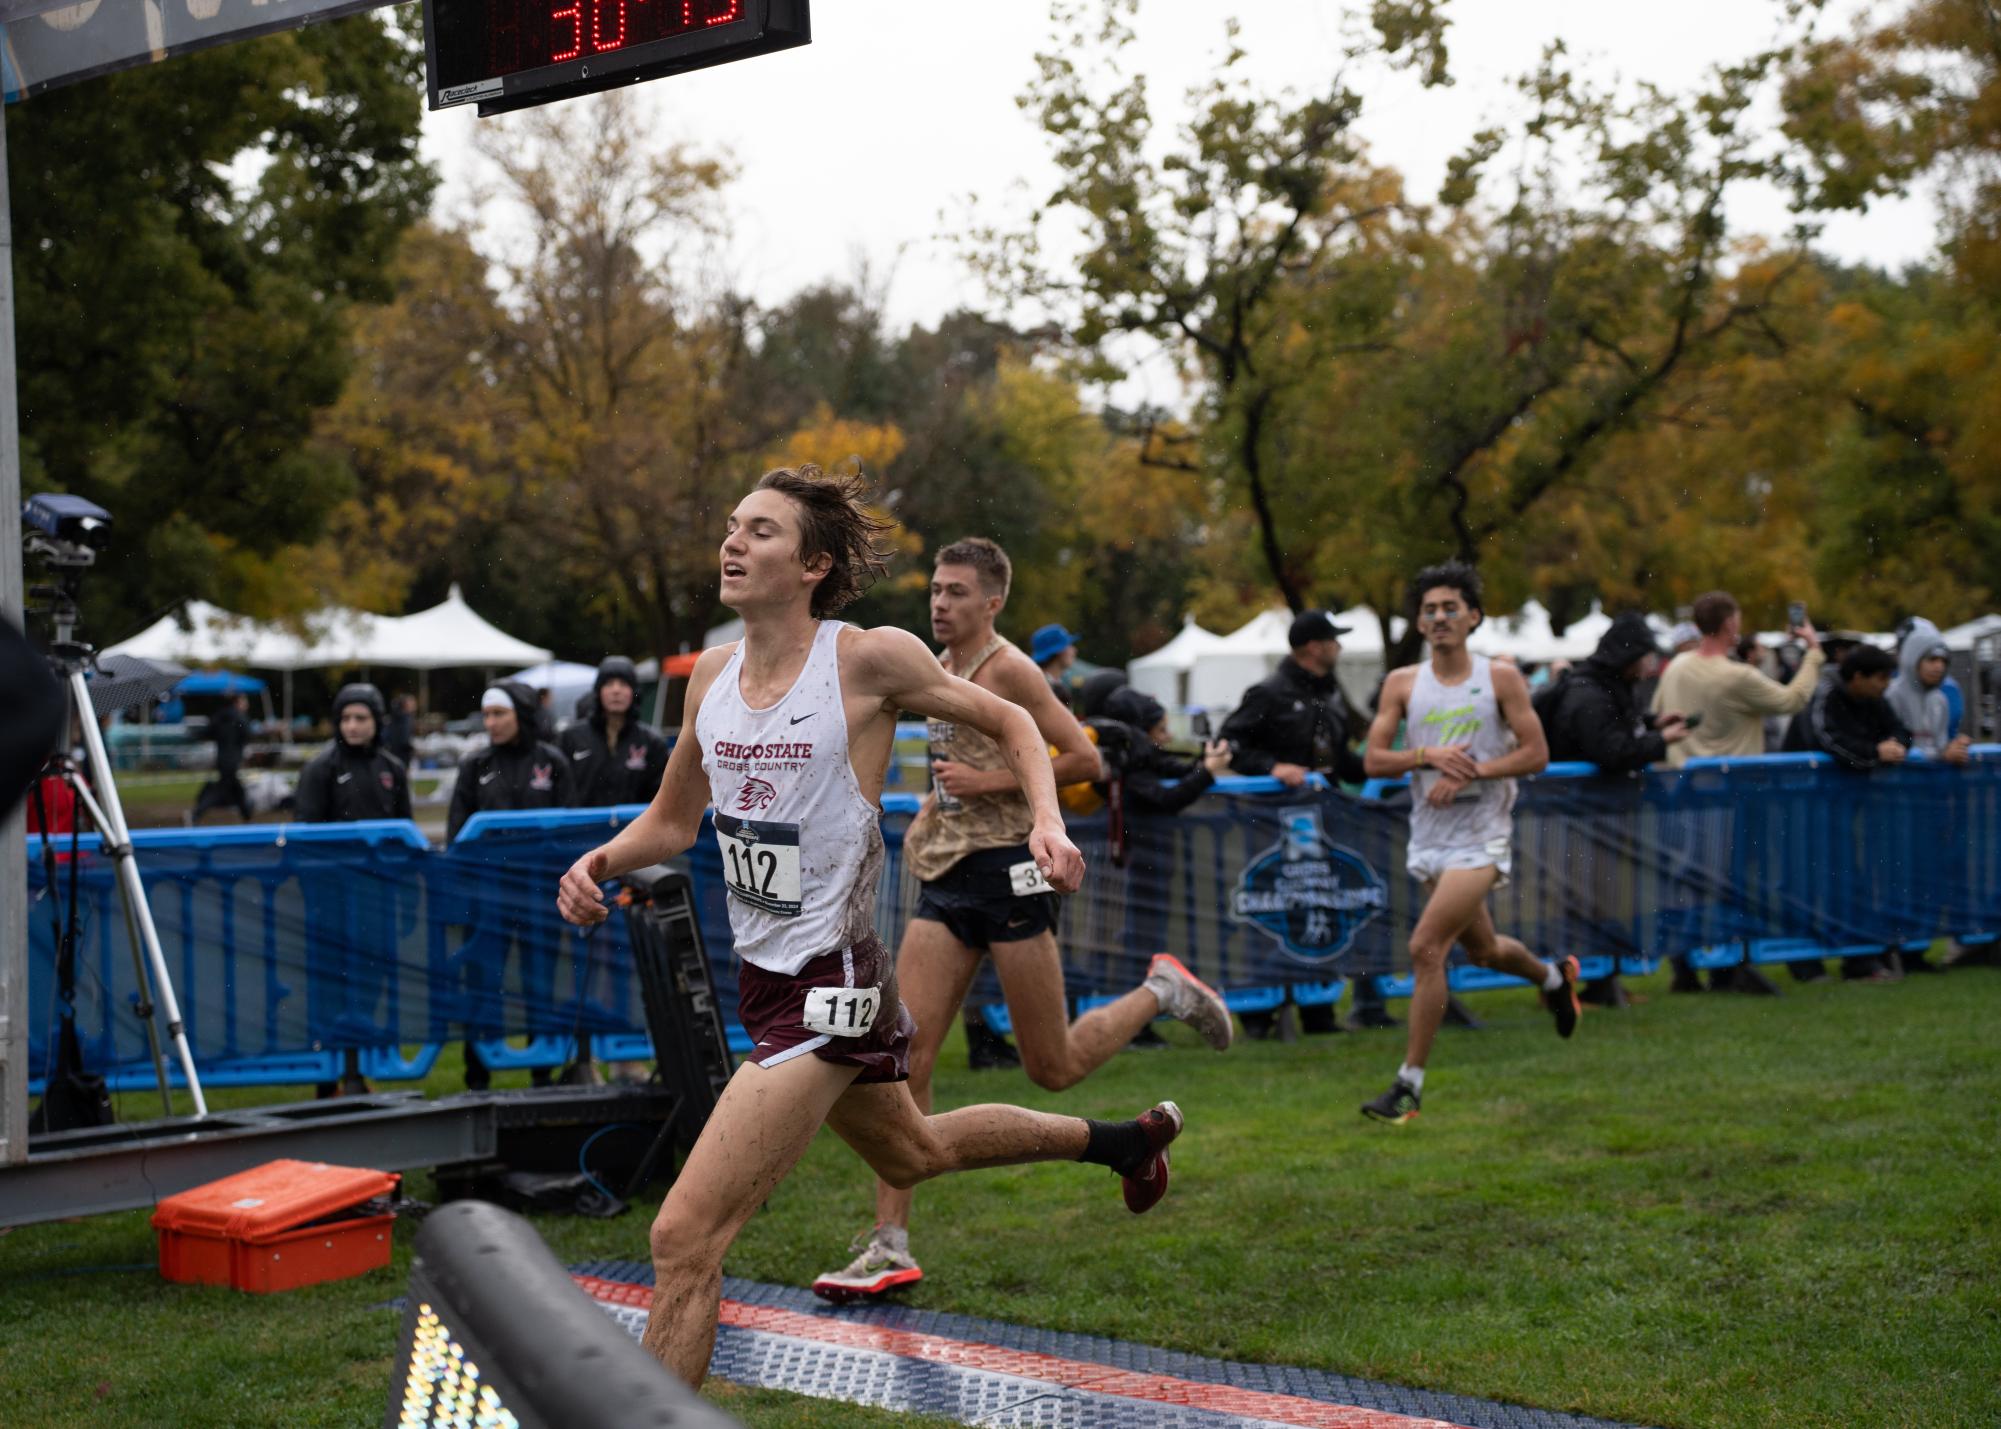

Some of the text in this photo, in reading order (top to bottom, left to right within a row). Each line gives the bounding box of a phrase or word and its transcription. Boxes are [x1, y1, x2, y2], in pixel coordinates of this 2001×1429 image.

[717, 760, 806, 771] CROSS COUNTRY
[728, 843, 778, 900] 112
[1024, 868, 1045, 888] 3
[825, 995, 872, 1029] 112
